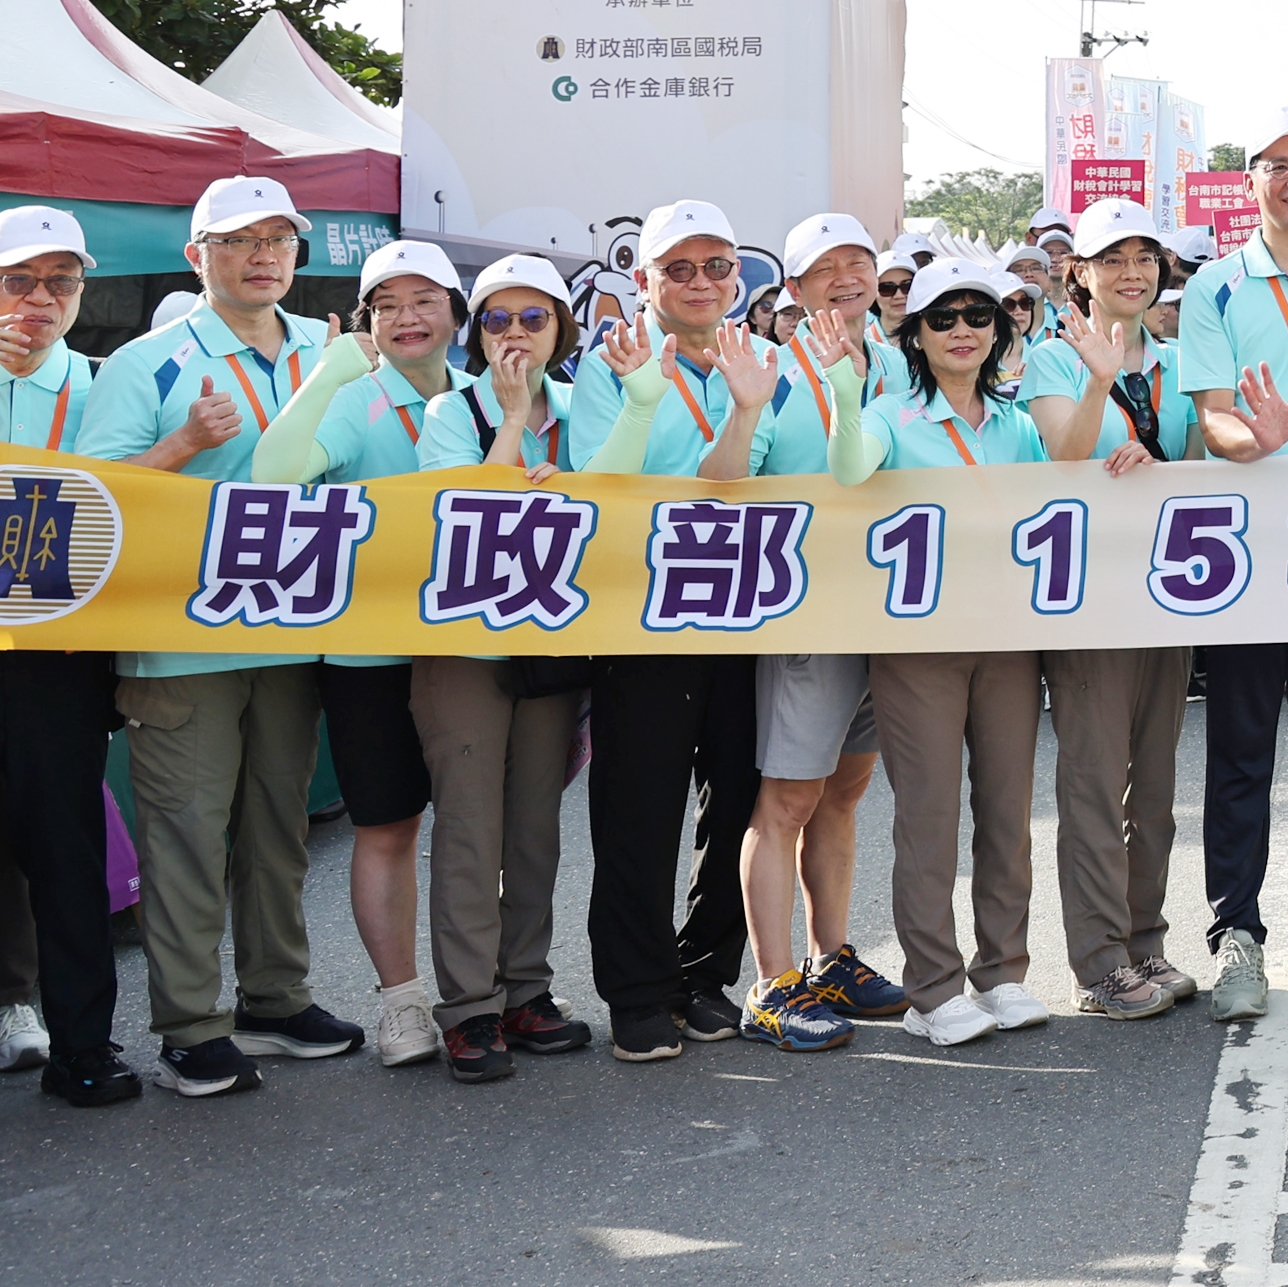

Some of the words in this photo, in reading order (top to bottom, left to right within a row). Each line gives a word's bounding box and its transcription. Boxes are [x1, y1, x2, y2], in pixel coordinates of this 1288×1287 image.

[589, 76, 735, 99] 合作金庫銀行
[1084, 166, 1132, 179] 中華民國
[1188, 185, 1247, 196] 台南市記帳
[1199, 197, 1244, 210] 職業工會
